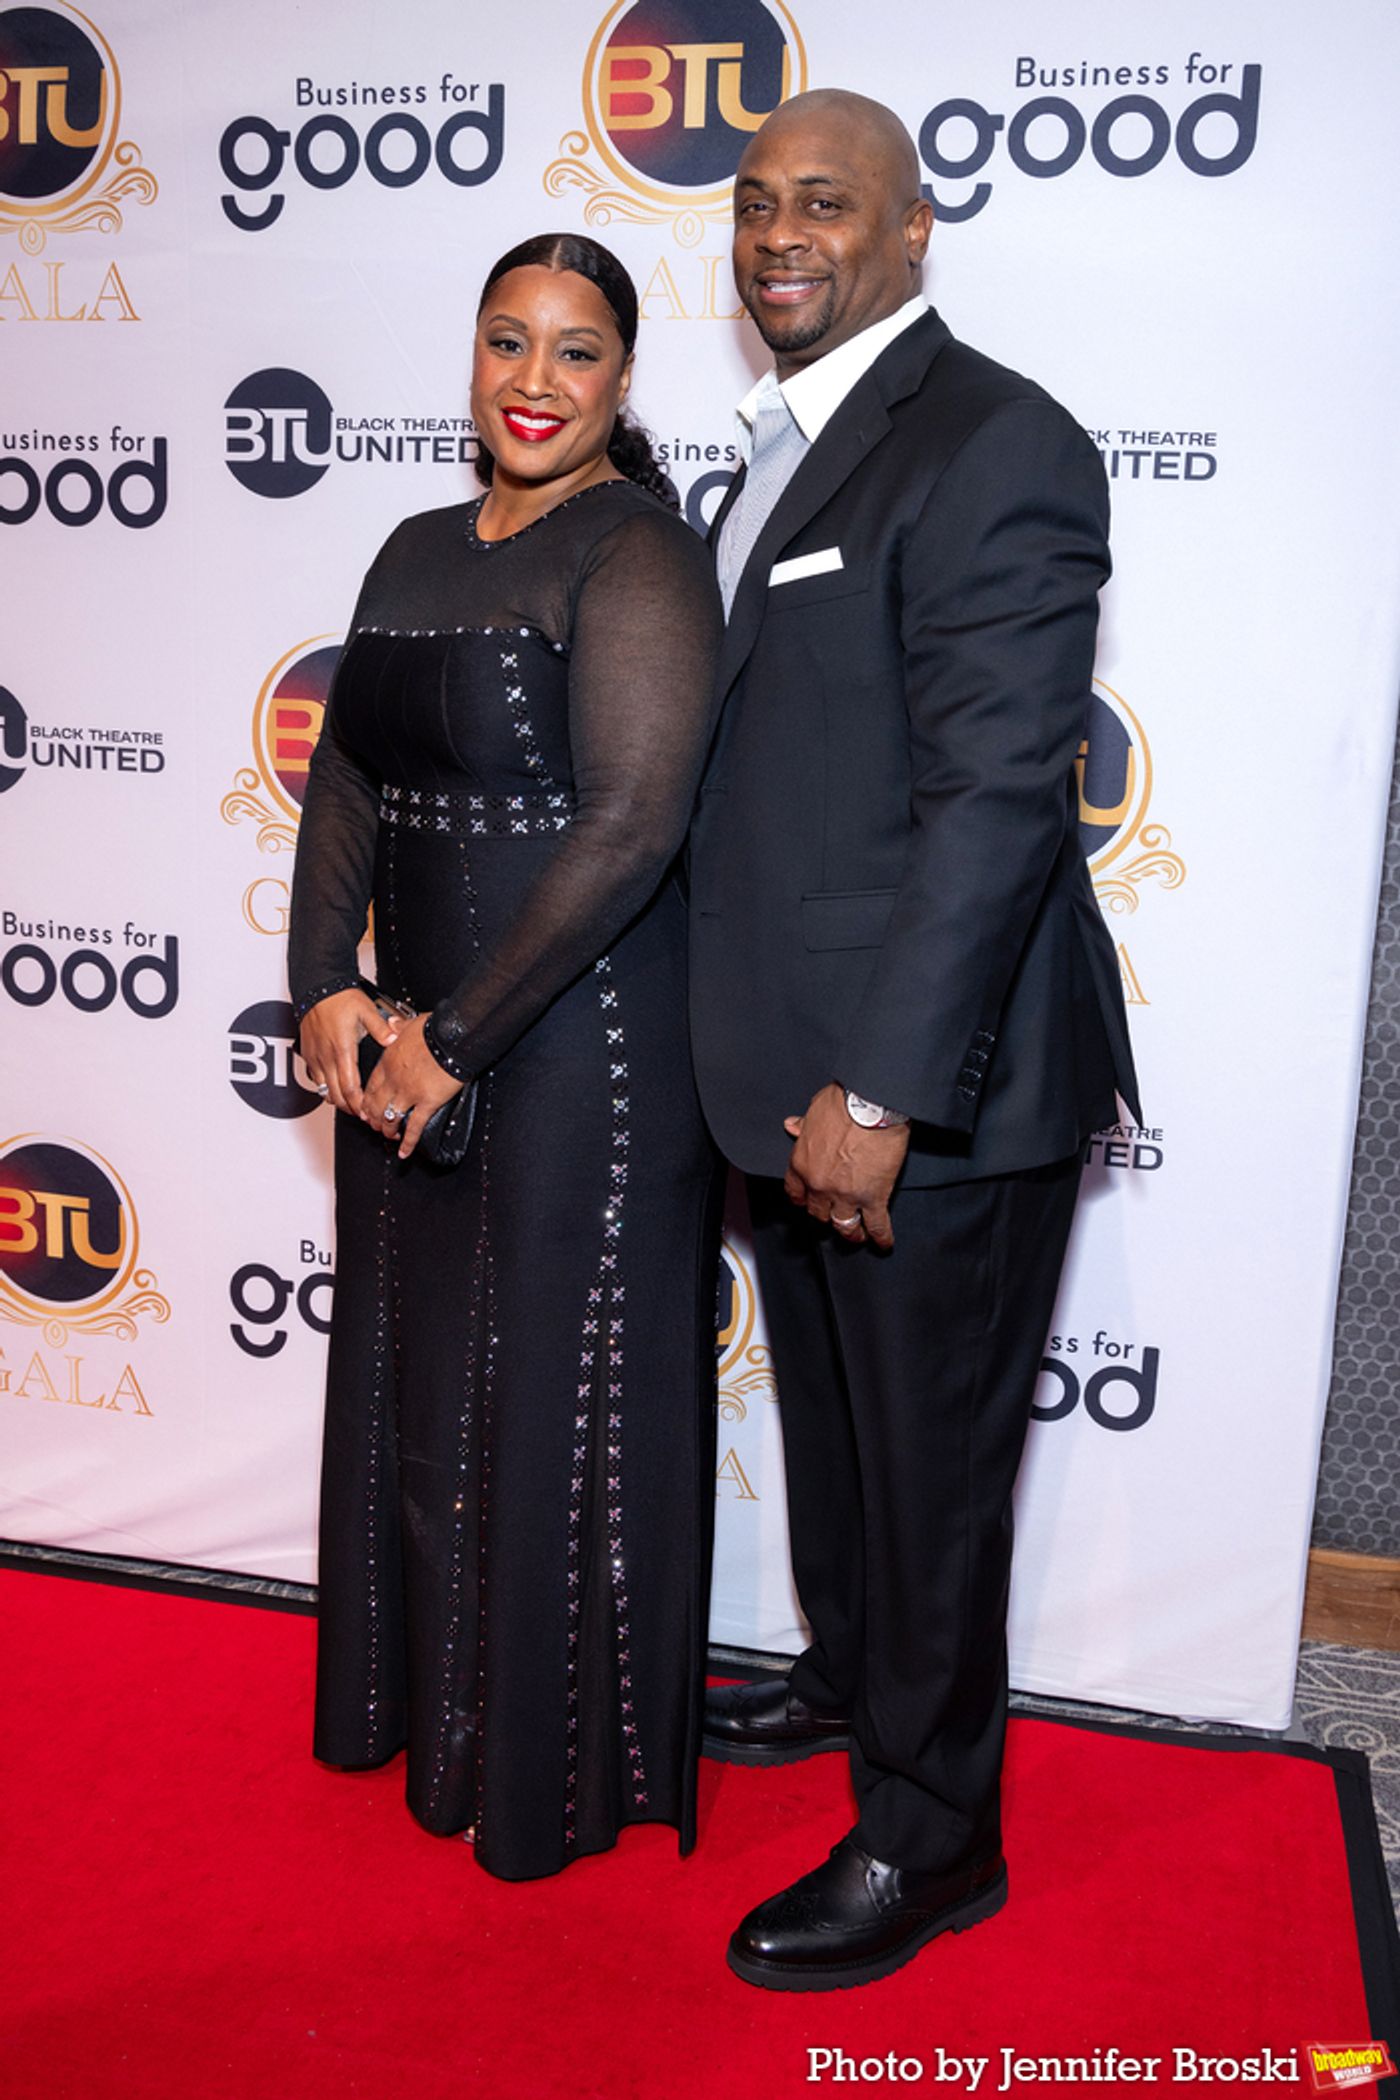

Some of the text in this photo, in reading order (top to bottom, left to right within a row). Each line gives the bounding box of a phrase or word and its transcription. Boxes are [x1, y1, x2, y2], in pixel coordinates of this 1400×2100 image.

[599, 42, 792, 133] BTU
[1015, 52, 1233, 88] Business for
[0, 66, 108, 148] TU
[296, 73, 479, 106] Business for
[219, 83, 505, 232] good
[918, 64, 1262, 223] good
[0, 261, 142, 321] ALA
[638, 256, 753, 320] AL
[3, 425, 145, 452] usiness for
[222, 407, 334, 466] BTU
[335, 417, 478, 432] BLACK THEATR
[1118, 430, 1217, 447] THEATRE
[336, 435, 482, 464] UNITED
[658, 438, 736, 462] sines
[1100, 449, 1217, 481] ITED
[0, 436, 168, 529] ood
[30, 725, 164, 745] BLACK THEATRE
[31, 742, 166, 773] UNITED
[2, 911, 157, 948] Business for
[0, 935, 179, 1019] ood
[1085, 1141, 1163, 1170] TED
[229, 1262, 337, 1359] go
[1092, 1330, 1135, 1360] for
[0, 1347, 155, 1417] ALA
[1030, 1345, 1160, 1432] od
